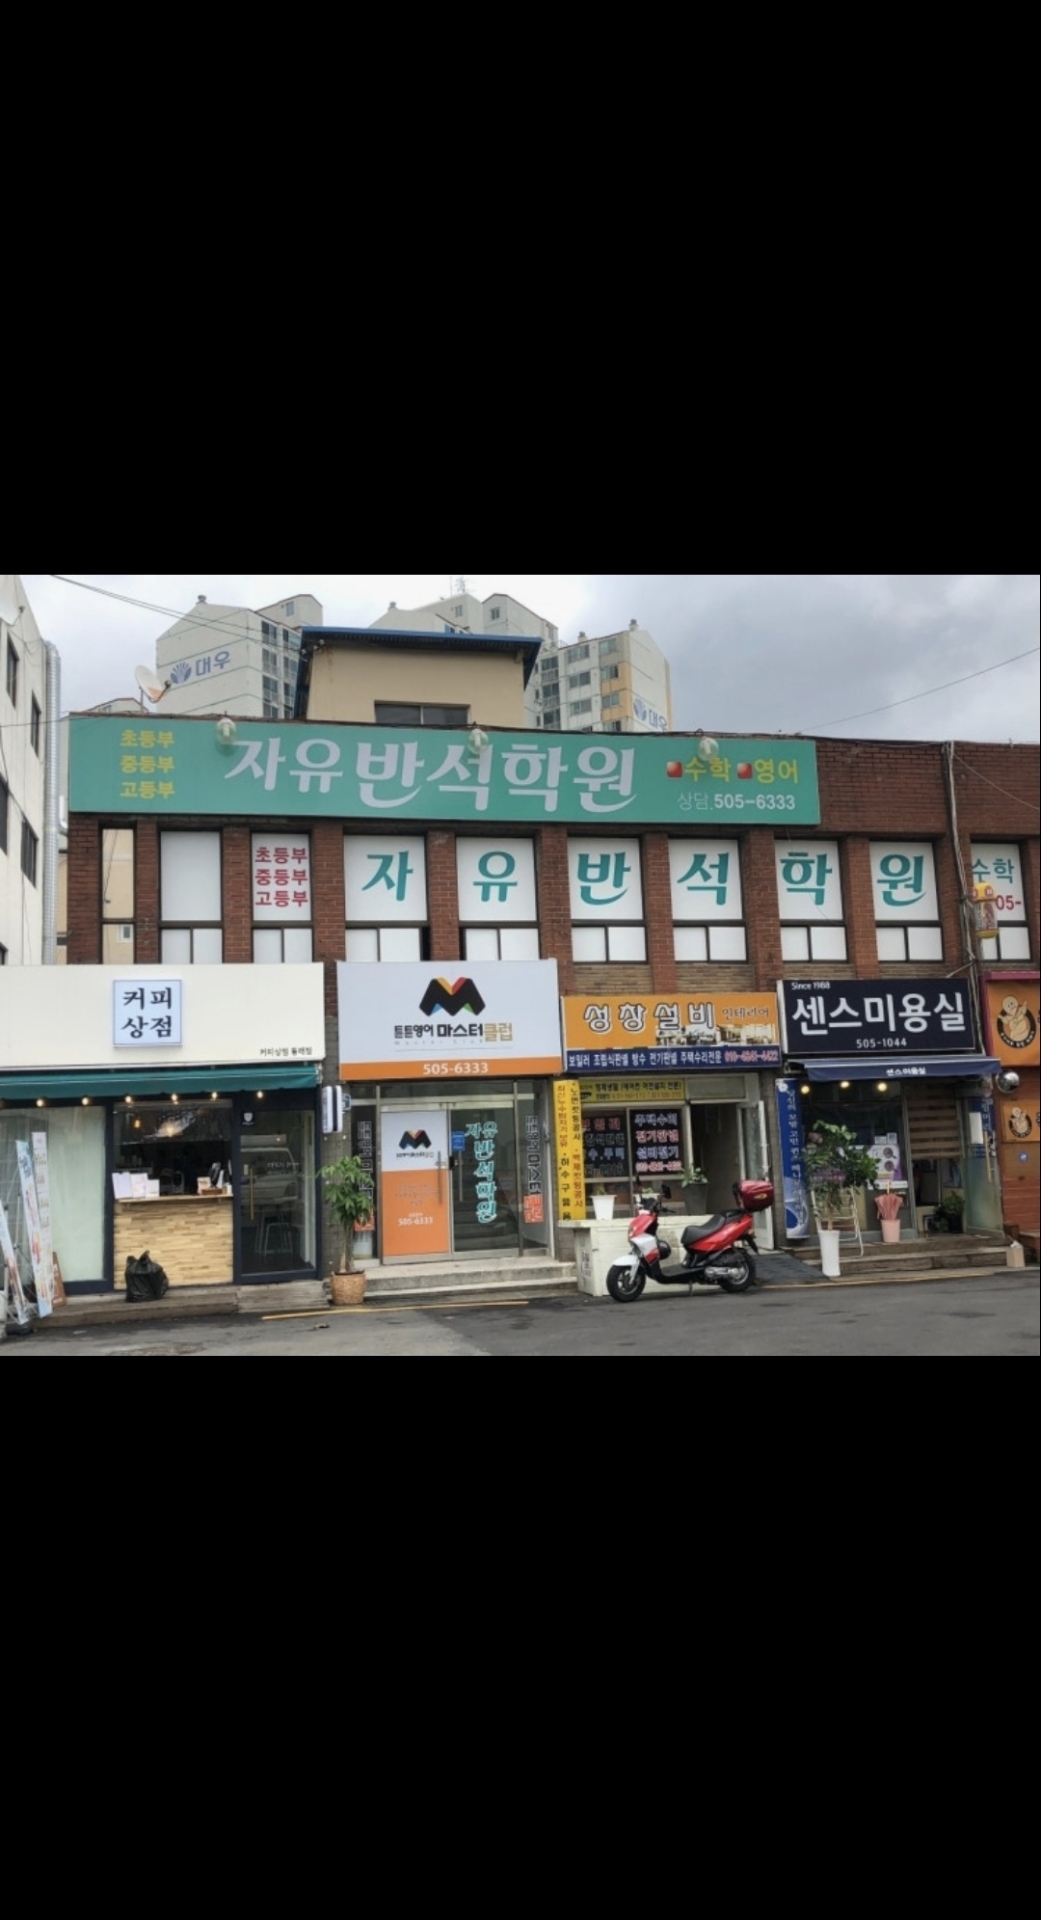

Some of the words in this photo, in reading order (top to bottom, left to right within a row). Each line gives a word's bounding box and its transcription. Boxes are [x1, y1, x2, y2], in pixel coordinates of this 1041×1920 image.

[195, 651, 231, 677] 대우
[119, 730, 175, 748] 초등부
[119, 755, 175, 774] 중등부
[684, 757, 732, 782] 수학
[754, 758, 799, 784] 영어
[224, 736, 638, 813] 자유반석학원
[119, 780, 175, 799] 고등부
[714, 793, 796, 810] 505-6333
[254, 847, 308, 864] 초등부
[254, 869, 308, 886] 중등부
[361, 850, 413, 902] 자
[473, 850, 518, 902] 유
[575, 851, 631, 905] 반
[676, 852, 730, 906] 석
[780, 852, 832, 906] 학
[876, 854, 927, 907] 원
[972, 858, 1015, 884] 수학
[254, 890, 308, 908] 고등부
[995, 895, 1022, 911] 05-
[791, 982, 812, 990] Since
[123, 987, 173, 1010] 커피
[583, 1002, 716, 1033] 성창설비
[722, 1006, 770, 1021] 인테리어
[791, 992, 967, 1036] 센스미용실
[121, 1015, 173, 1039] 상점
[394, 1024, 434, 1039] 튼튼영어
[436, 1022, 513, 1042] 마스터클럽
[856, 1038, 908, 1049] 505-1044
[422, 1062, 489, 1075] 505-6333
[568, 1054, 590, 1068] 보일러
